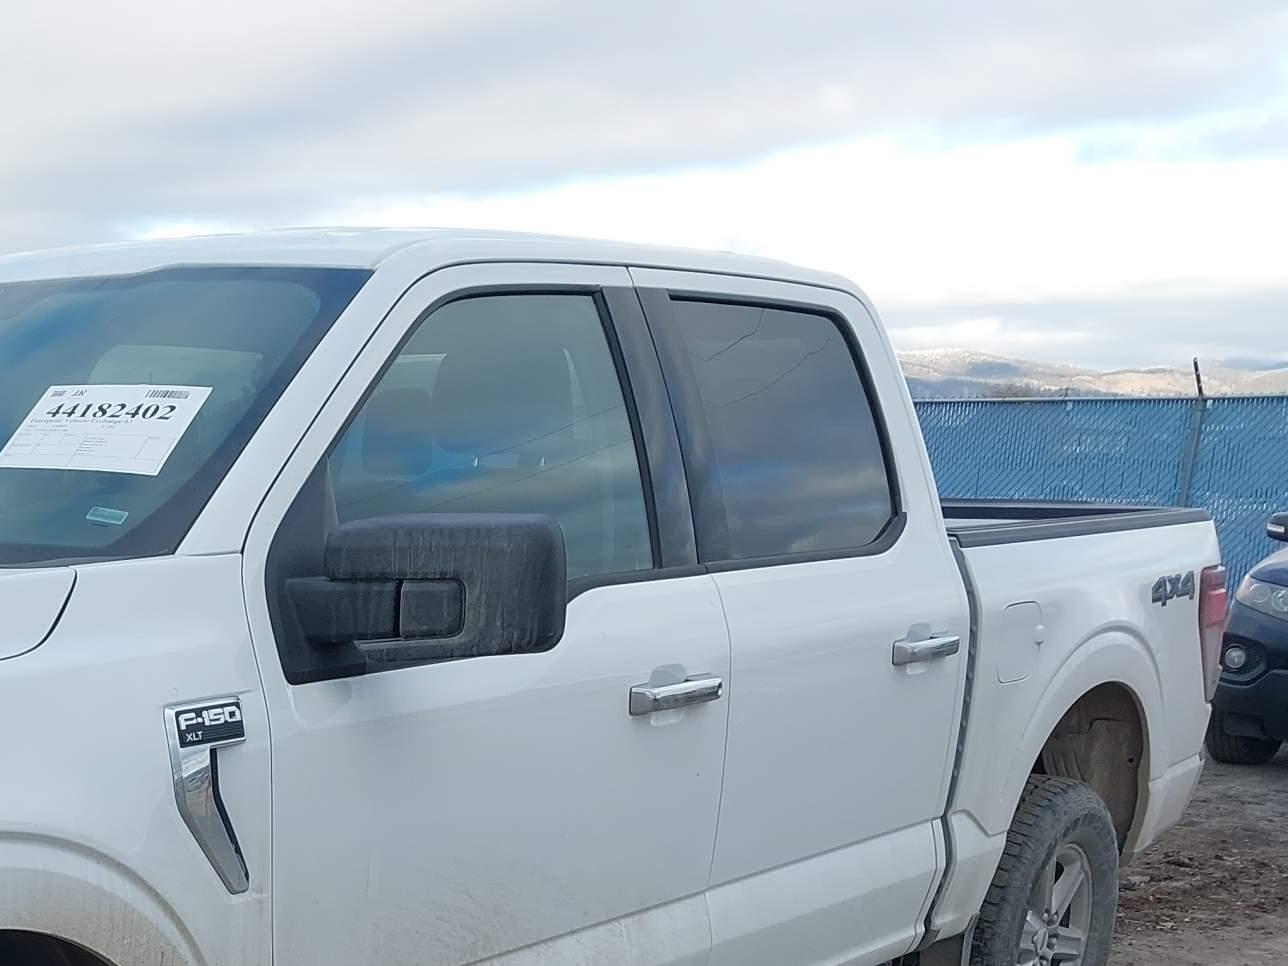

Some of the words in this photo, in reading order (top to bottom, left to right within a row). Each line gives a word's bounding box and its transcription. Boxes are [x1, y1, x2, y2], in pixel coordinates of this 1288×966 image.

[46, 402, 177, 420] 44182402
[178, 705, 242, 730] F-150
[185, 731, 203, 742] XLT
